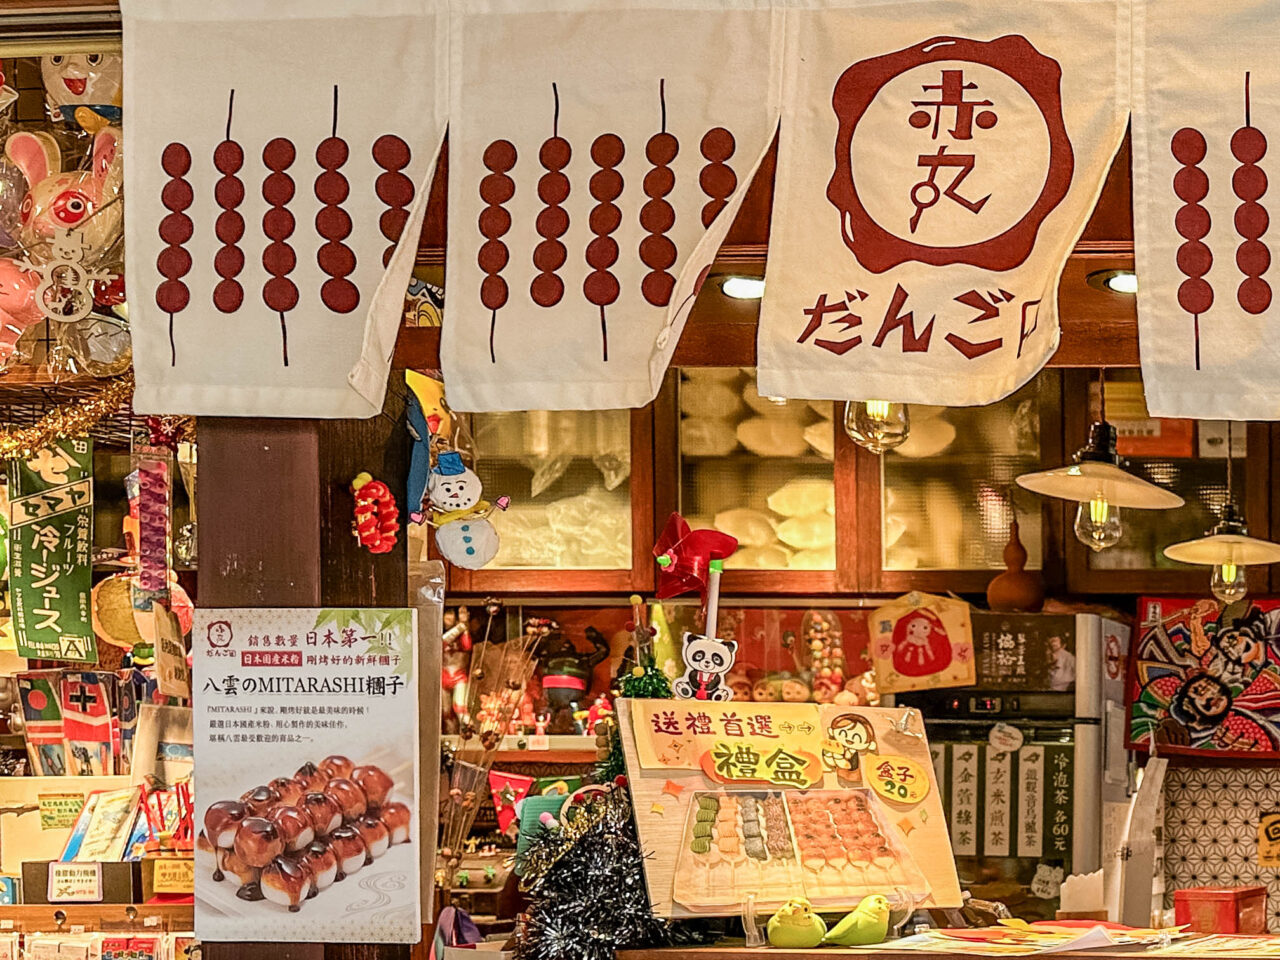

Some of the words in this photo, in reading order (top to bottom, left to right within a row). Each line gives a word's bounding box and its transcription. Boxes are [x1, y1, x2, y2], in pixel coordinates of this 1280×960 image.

[908, 69, 998, 234] 赤丸
[63, 523, 76, 576] フルーツ
[651, 711, 780, 739] 送禮首選
[713, 741, 810, 787] 禮盒
[875, 760, 916, 785] 盒子
